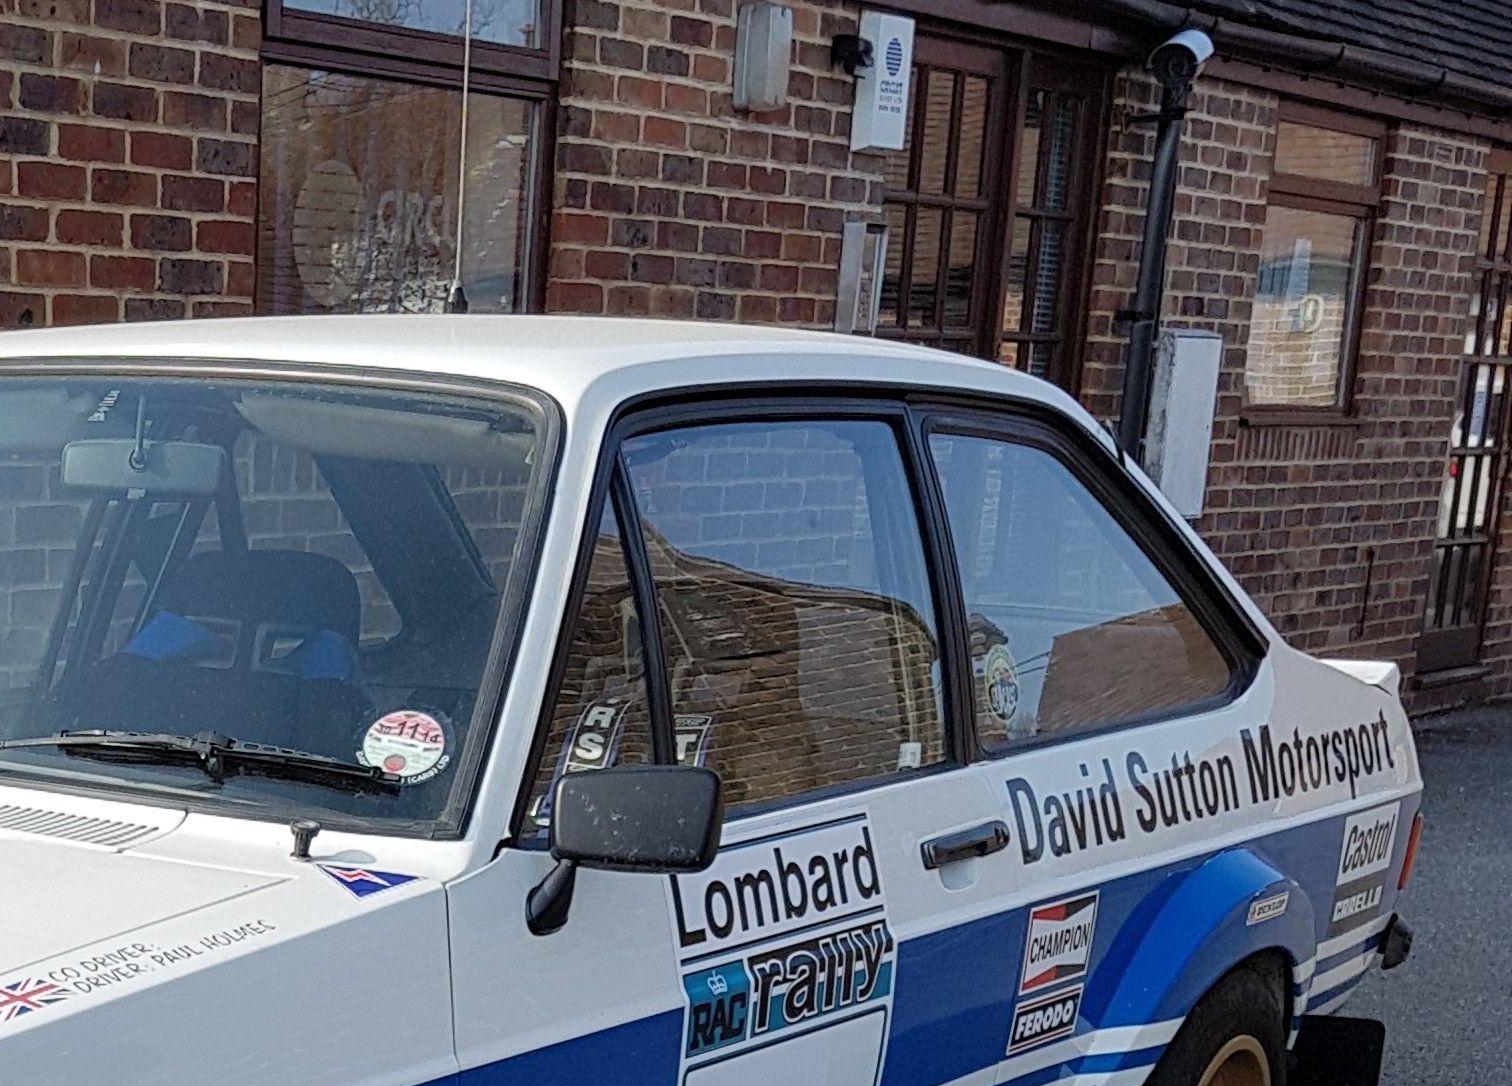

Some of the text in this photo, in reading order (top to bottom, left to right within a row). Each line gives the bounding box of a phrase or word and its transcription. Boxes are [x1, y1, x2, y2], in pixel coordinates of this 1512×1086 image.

[1006, 708, 1395, 866] David Sutton Motorsport
[1341, 812, 1397, 875] Castrol
[668, 826, 881, 948] Lombard
[156, 943, 204, 968] PAUL
[201, 918, 277, 951] HOLMES
[1029, 922, 1091, 964] CHAMPION
[48, 966, 81, 984] CO
[751, 925, 888, 1034] rally
[689, 994, 748, 1051] RAC
[1014, 998, 1075, 1041] FERODO
